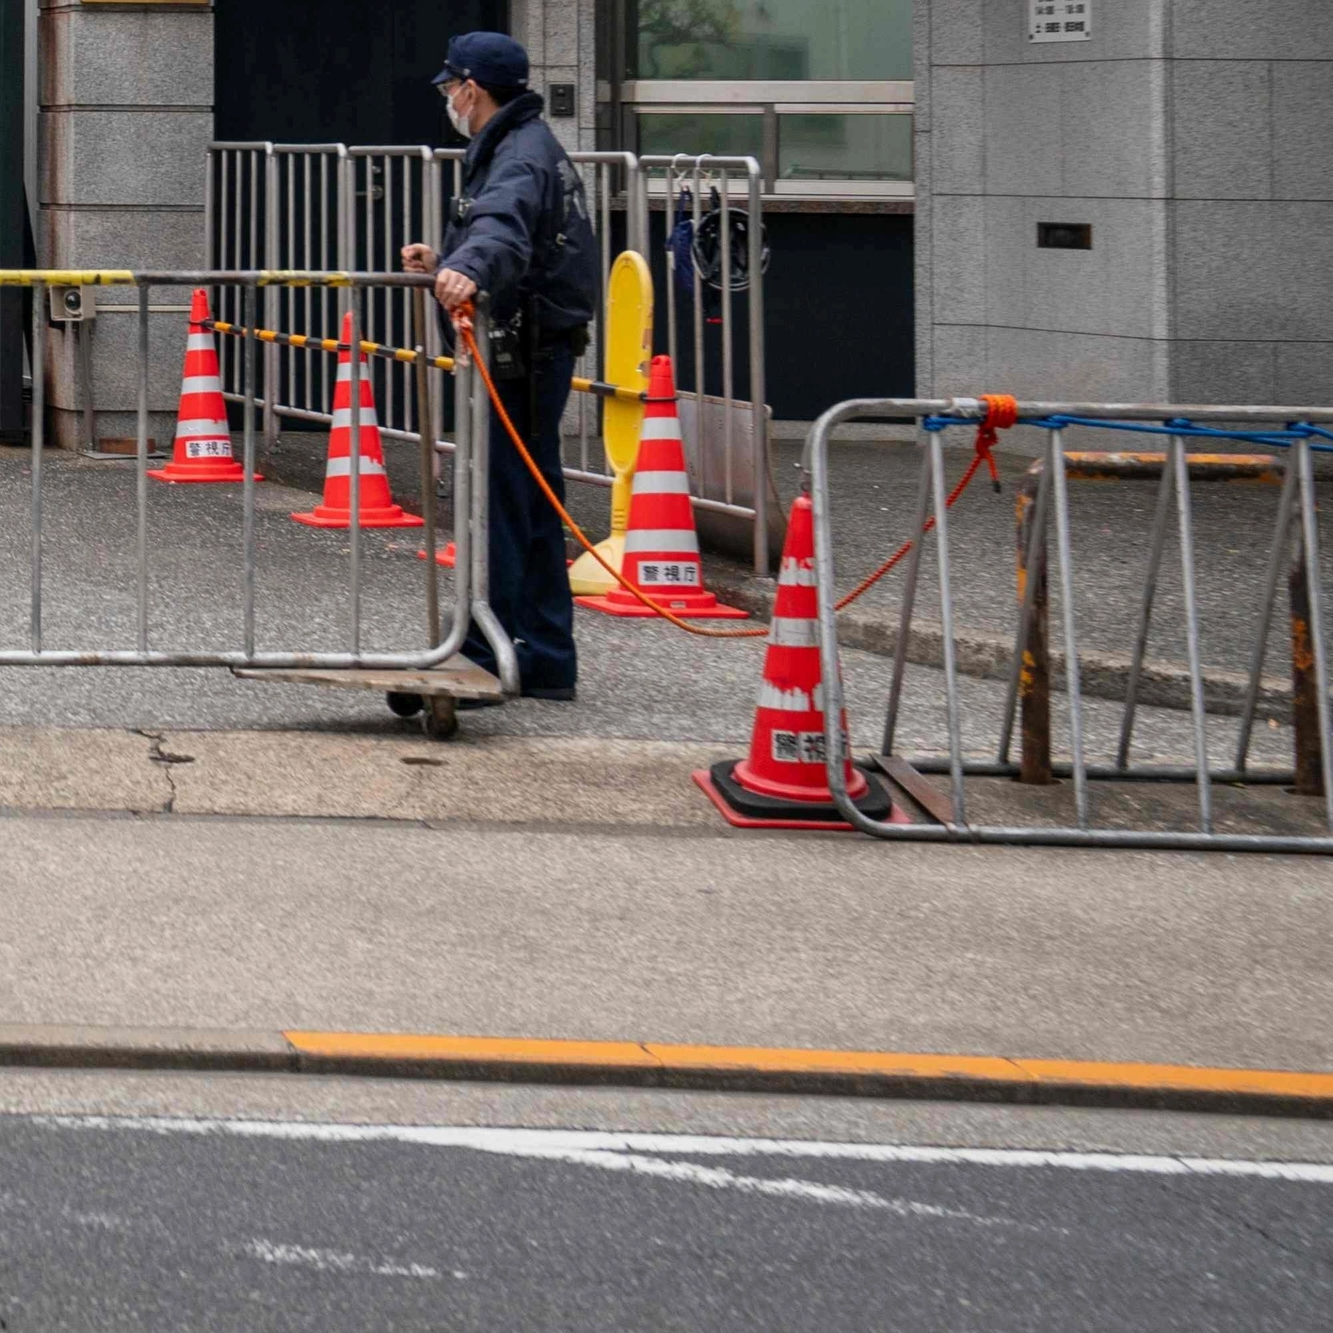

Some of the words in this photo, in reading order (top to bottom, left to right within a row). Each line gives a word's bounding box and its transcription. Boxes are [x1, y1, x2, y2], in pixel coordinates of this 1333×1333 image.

[189, 441, 231, 457] 警視庁
[643, 565, 696, 582] 警視庁
